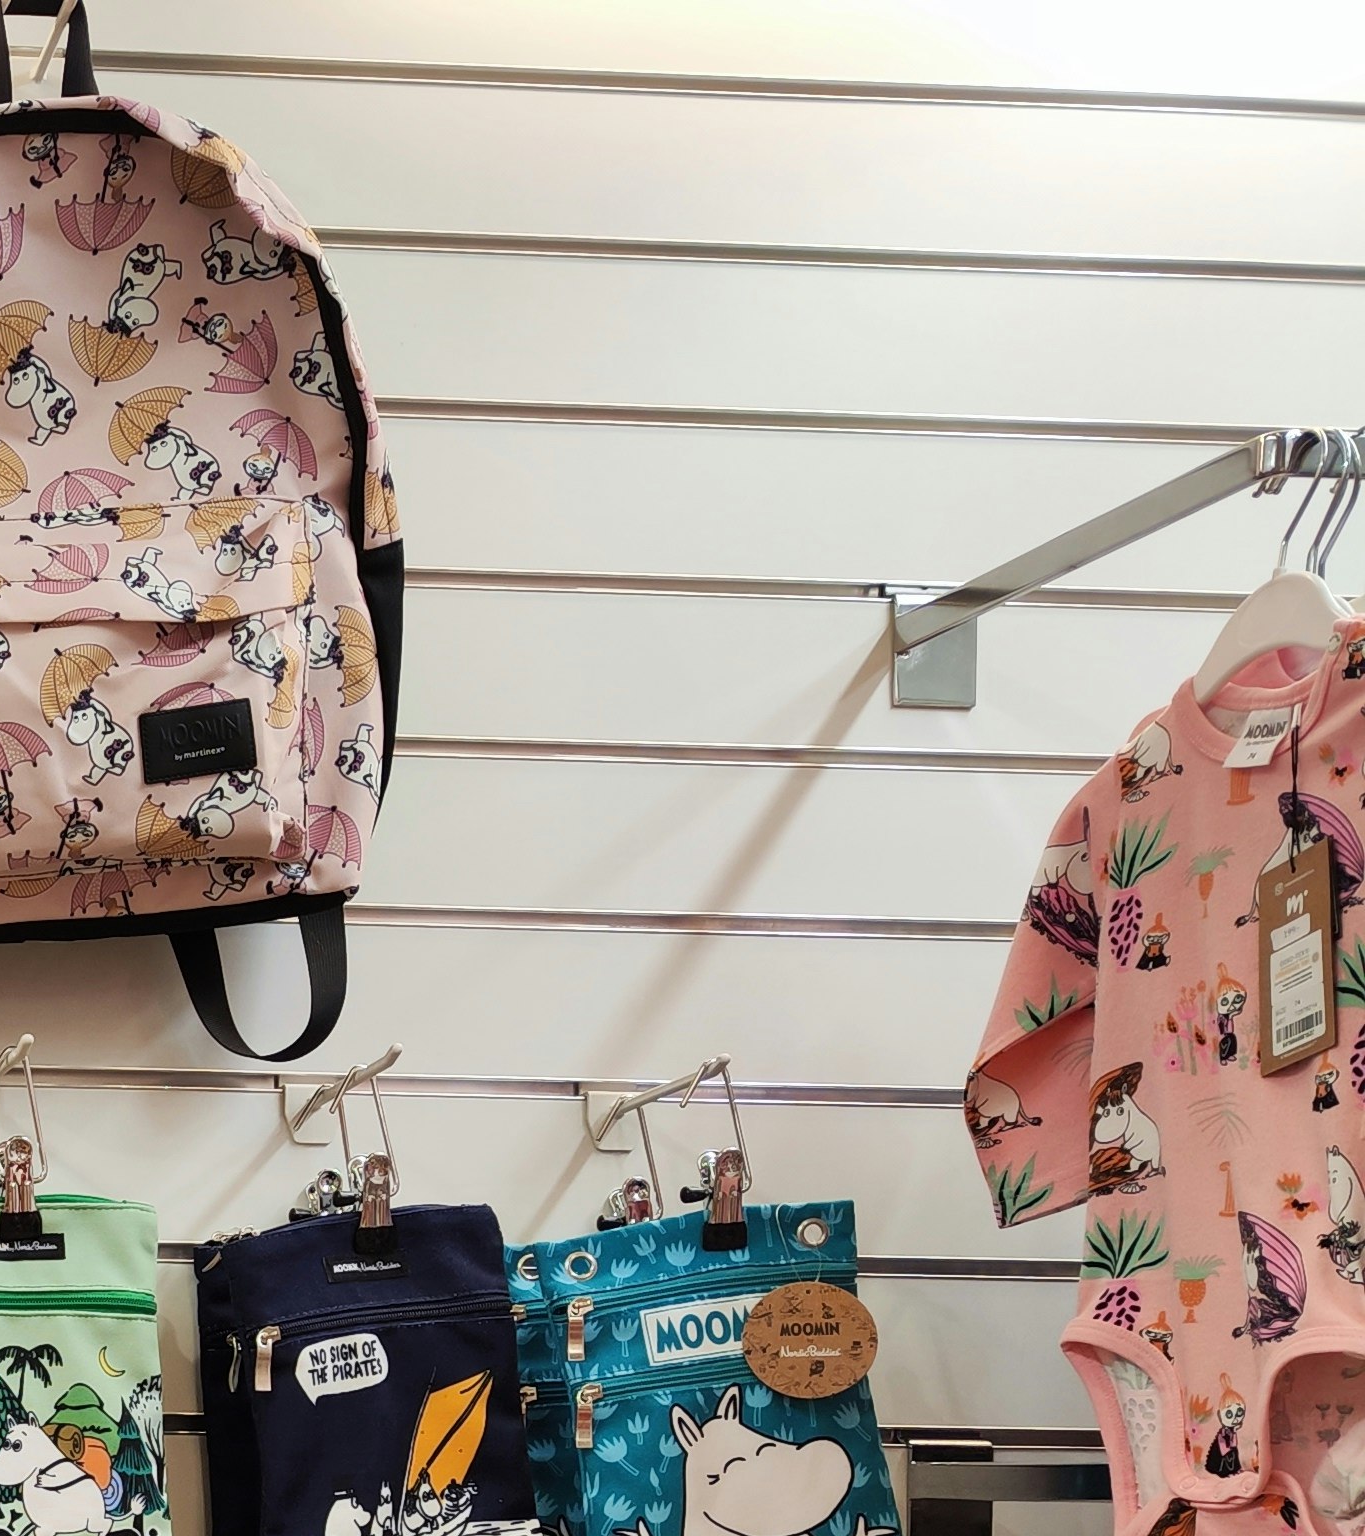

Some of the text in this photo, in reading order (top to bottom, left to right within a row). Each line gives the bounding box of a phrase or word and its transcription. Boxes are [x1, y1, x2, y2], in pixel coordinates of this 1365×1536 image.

[1244, 721, 1288, 739] MOOMIN
[780, 1321, 840, 1337] MOOMIN
[309, 1340, 377, 1367] NO SIGN OF
[308, 1357, 383, 1386] THE PIRATES
